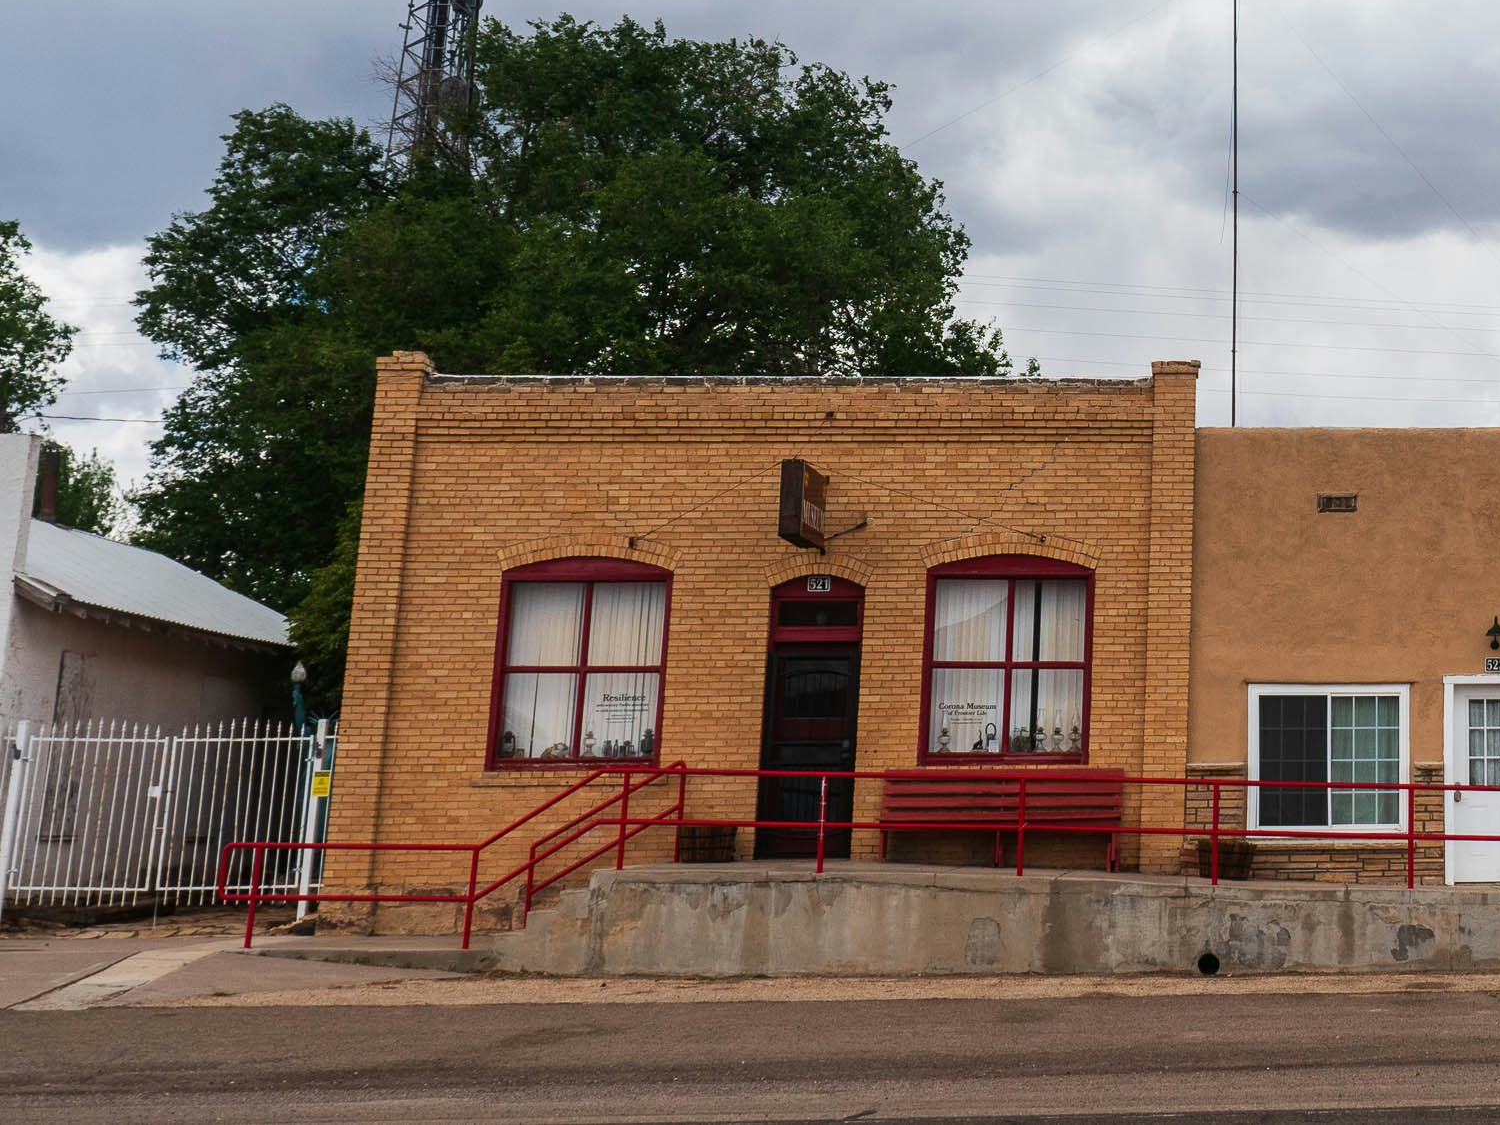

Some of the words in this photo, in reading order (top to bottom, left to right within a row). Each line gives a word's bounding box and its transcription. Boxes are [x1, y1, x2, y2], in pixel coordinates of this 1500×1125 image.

[809, 578, 828, 590] 521
[602, 693, 647, 703] Resilience
[938, 702, 965, 710] Corona
[966, 702, 997, 710] Museum
